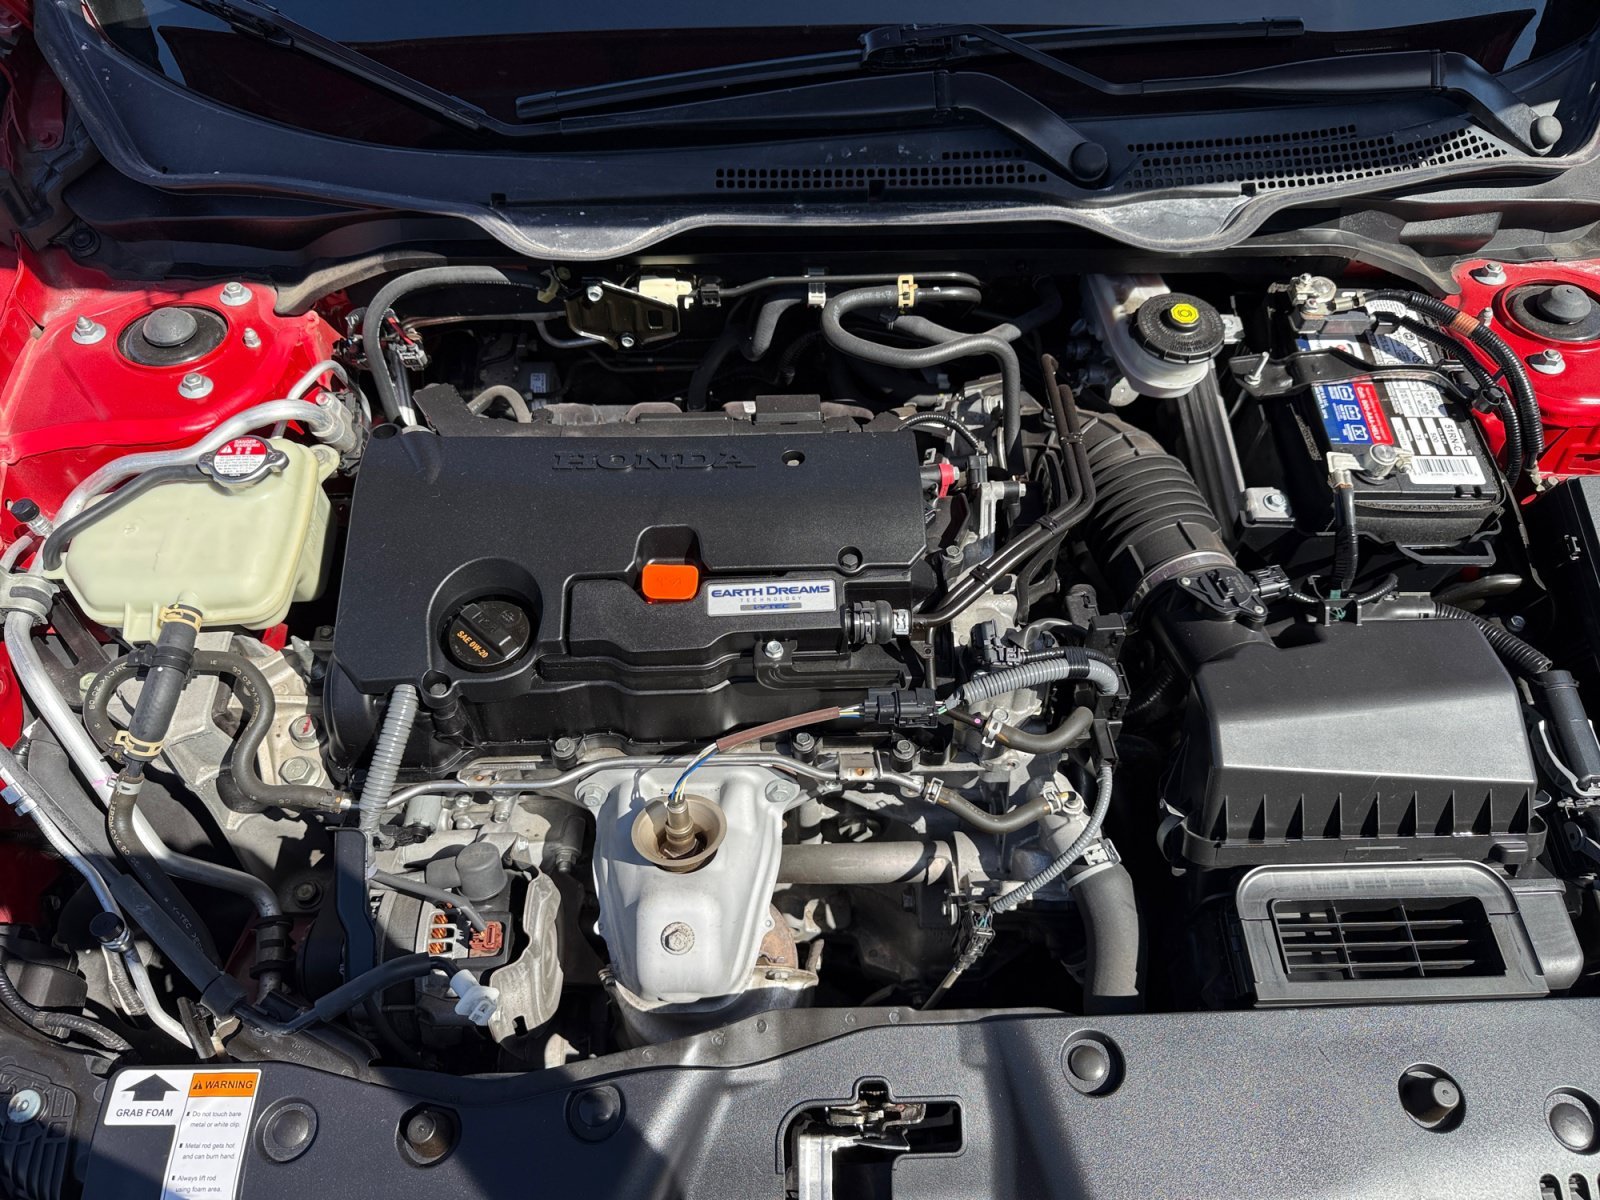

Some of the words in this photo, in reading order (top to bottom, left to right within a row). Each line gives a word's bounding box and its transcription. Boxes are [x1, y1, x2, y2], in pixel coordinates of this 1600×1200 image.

[1444, 424, 1463, 452] 51RN-C
[552, 453, 757, 471] HONDA
[711, 587, 763, 598] EARTH
[766, 585, 830, 596] DREAMS
[456, 630, 473, 644] SAE
[468, 641, 489, 659] 0W-20
[205, 1080, 253, 1090] WARNING
[116, 1108, 143, 1117] GRAB
[145, 1108, 173, 1117] FOAM
[175, 1186, 191, 1194] using
